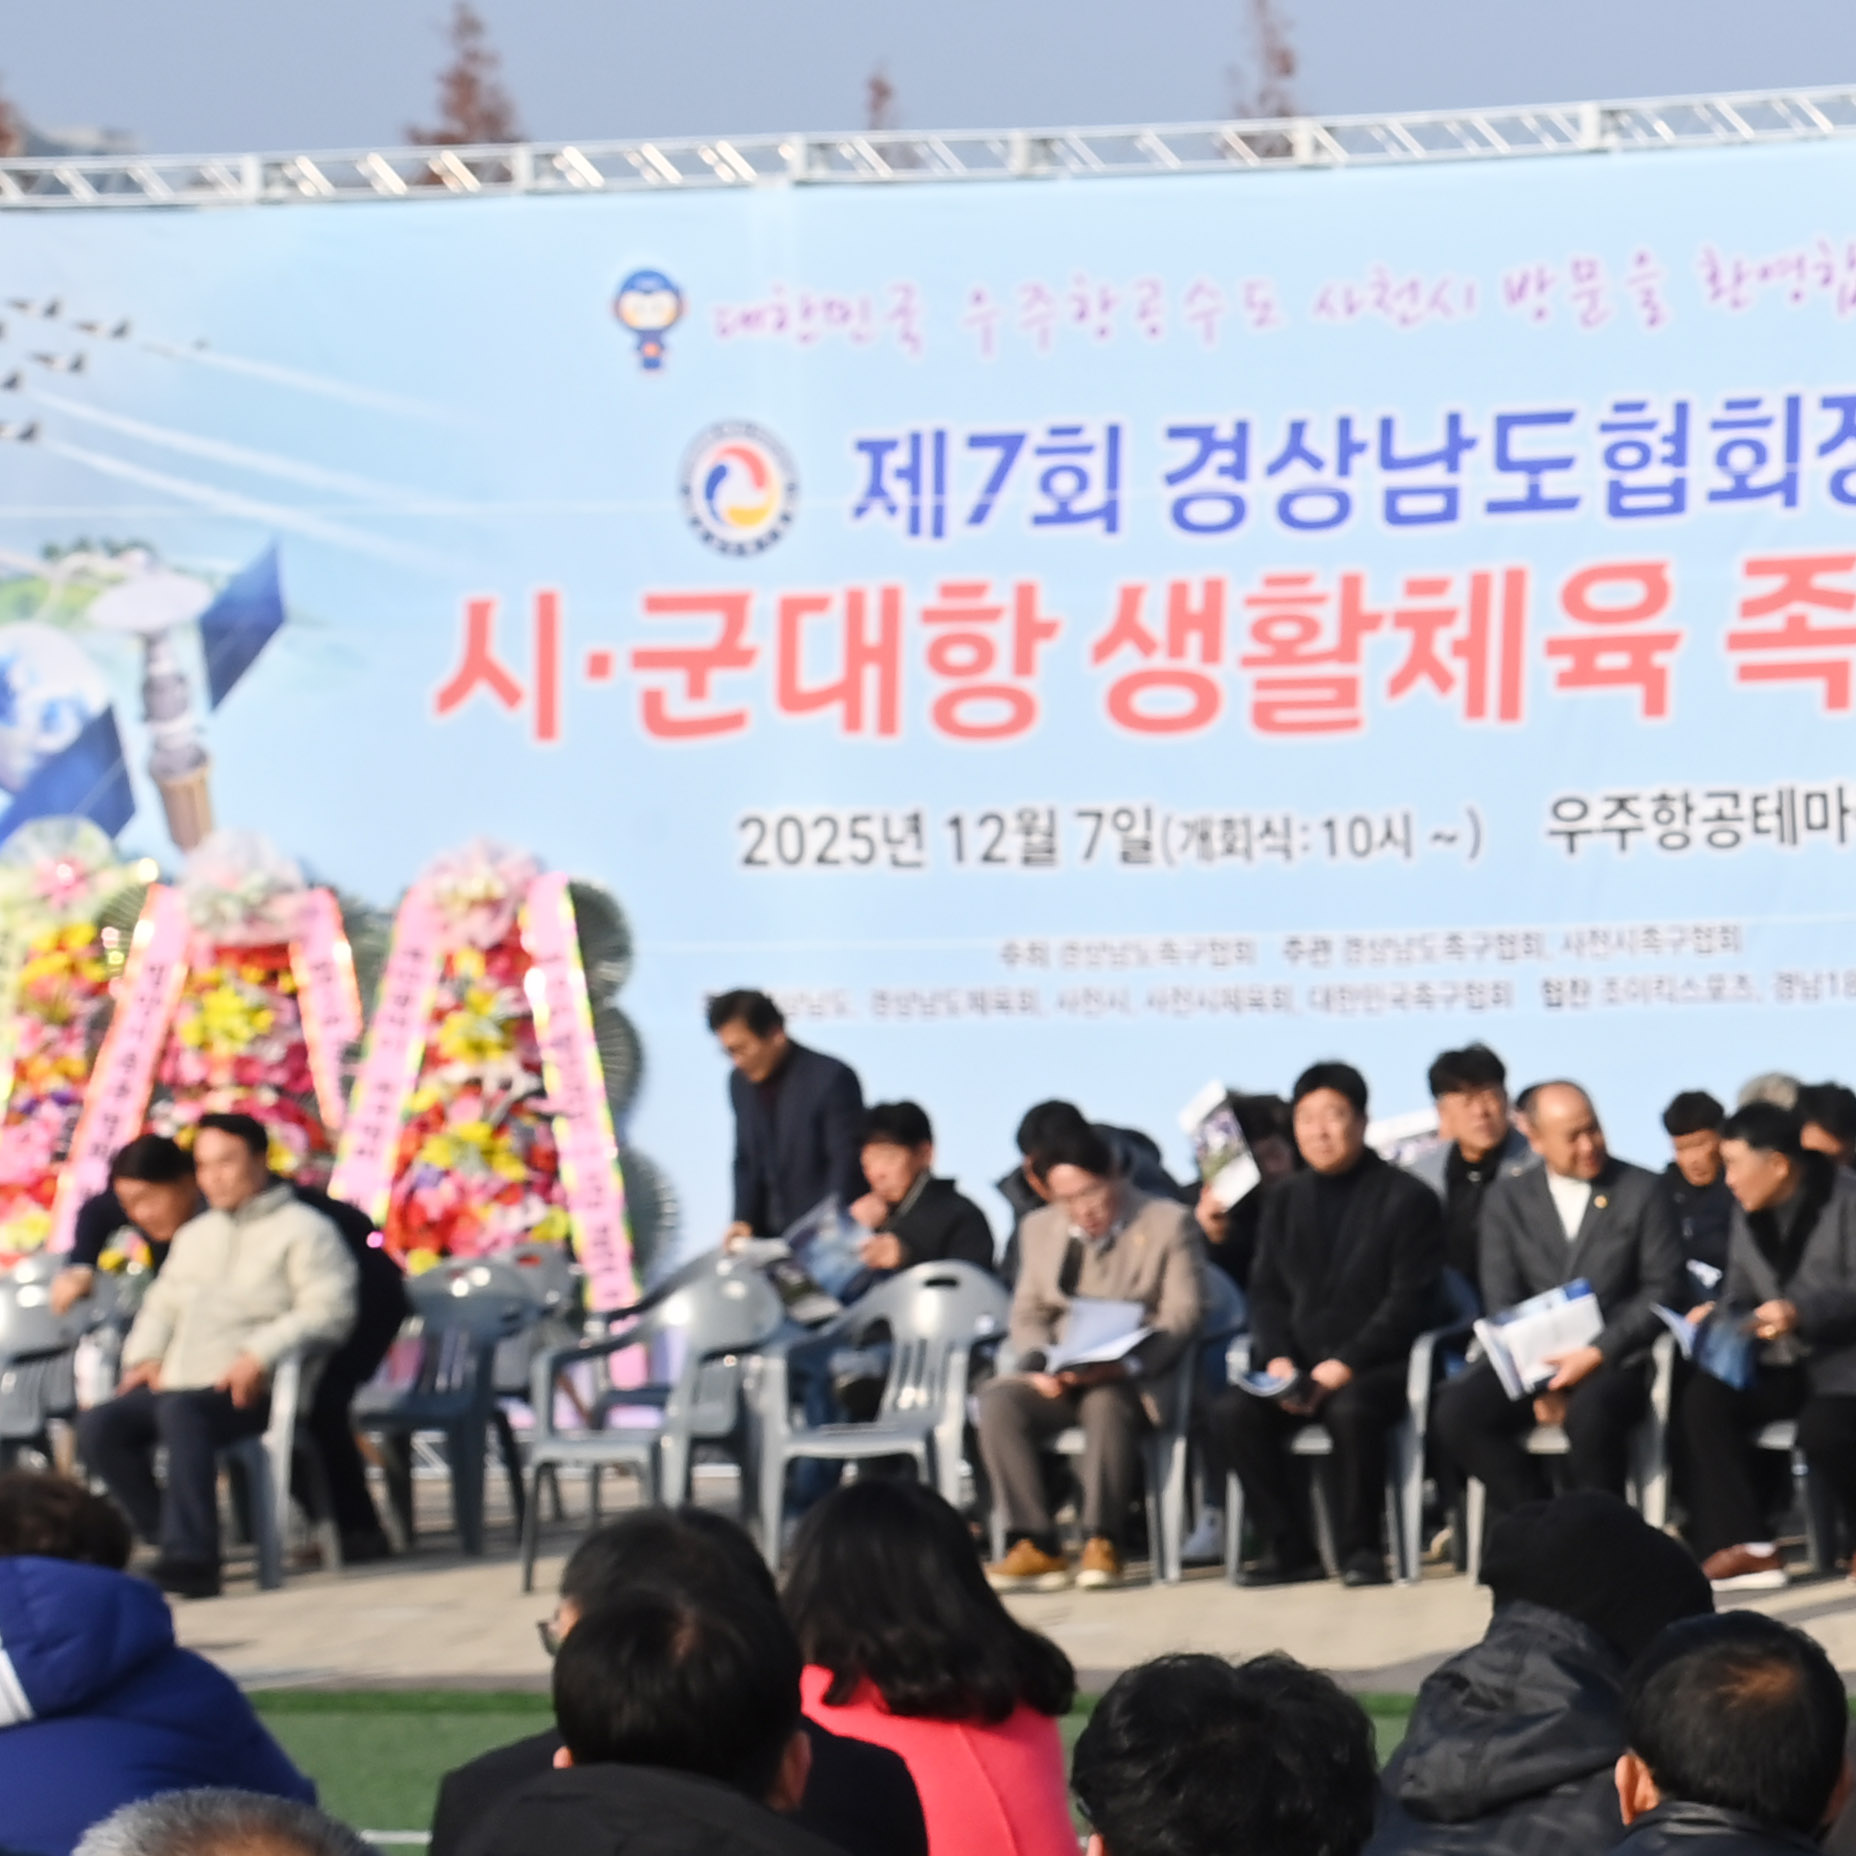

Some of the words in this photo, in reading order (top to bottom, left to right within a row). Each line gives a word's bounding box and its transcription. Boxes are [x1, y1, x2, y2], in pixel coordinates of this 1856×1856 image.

[1312, 267, 1477, 326] 사천시
[1503, 248, 1668, 328] 방문을
[851, 422, 1122, 539] 제7회
[434, 578, 1061, 742] 시·군대항
[1090, 558, 1683, 735] 생활체육
[737, 809, 925, 869] 2025년
[947, 807, 1060, 868] 12월
